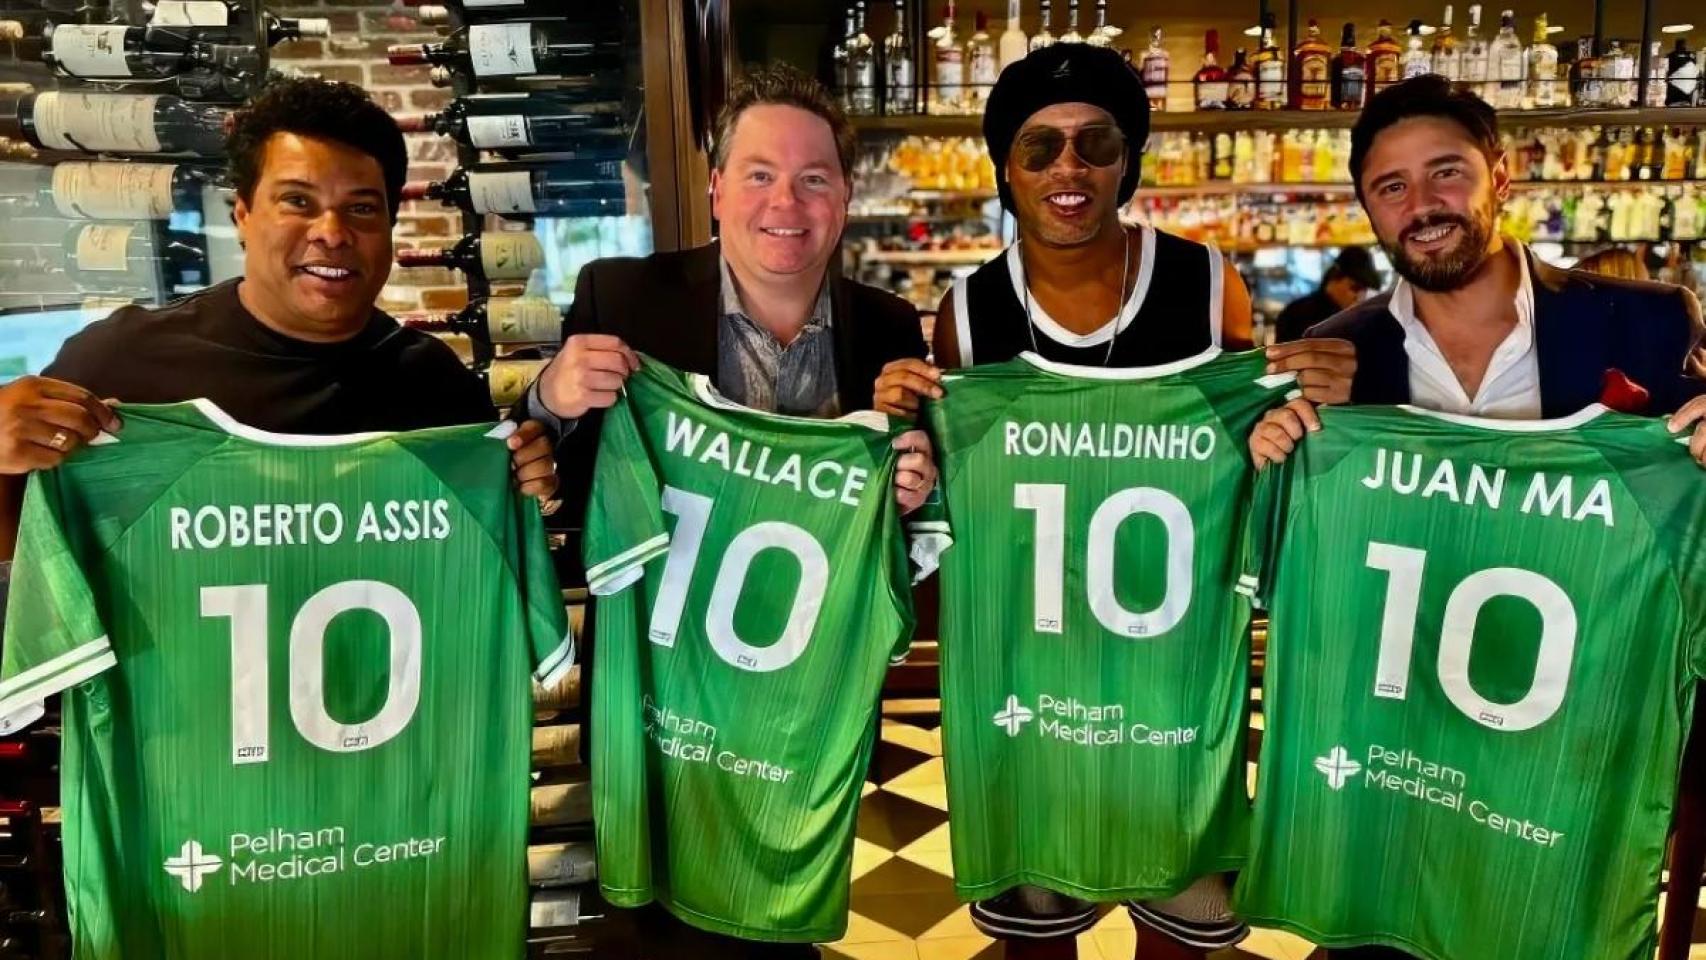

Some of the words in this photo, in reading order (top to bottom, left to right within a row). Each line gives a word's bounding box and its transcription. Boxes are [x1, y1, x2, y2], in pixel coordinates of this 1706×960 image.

[665, 411, 868, 507] WALLACE
[1004, 421, 1216, 461] RONALDINHO
[1361, 448, 1507, 510] JUAN
[1520, 472, 1615, 527] MA
[170, 502, 343, 550] ROBERTO
[356, 499, 451, 543] ASSIS
[648, 485, 829, 673] 10
[1014, 483, 1195, 638] 10
[1365, 541, 1578, 732] 10
[200, 579, 422, 765] 10
[1038, 694, 1124, 721] Pelham
[1039, 718, 1123, 746] Medical
[1130, 723, 1200, 745] Center
[716, 751, 794, 784] Center
[1367, 743, 1467, 788] Pelham
[1365, 769, 1464, 813] Medical
[1468, 800, 1565, 848] Center
[230, 826, 345, 857] Pelham
[230, 846, 345, 886] Medical
[353, 836, 447, 866] Center
